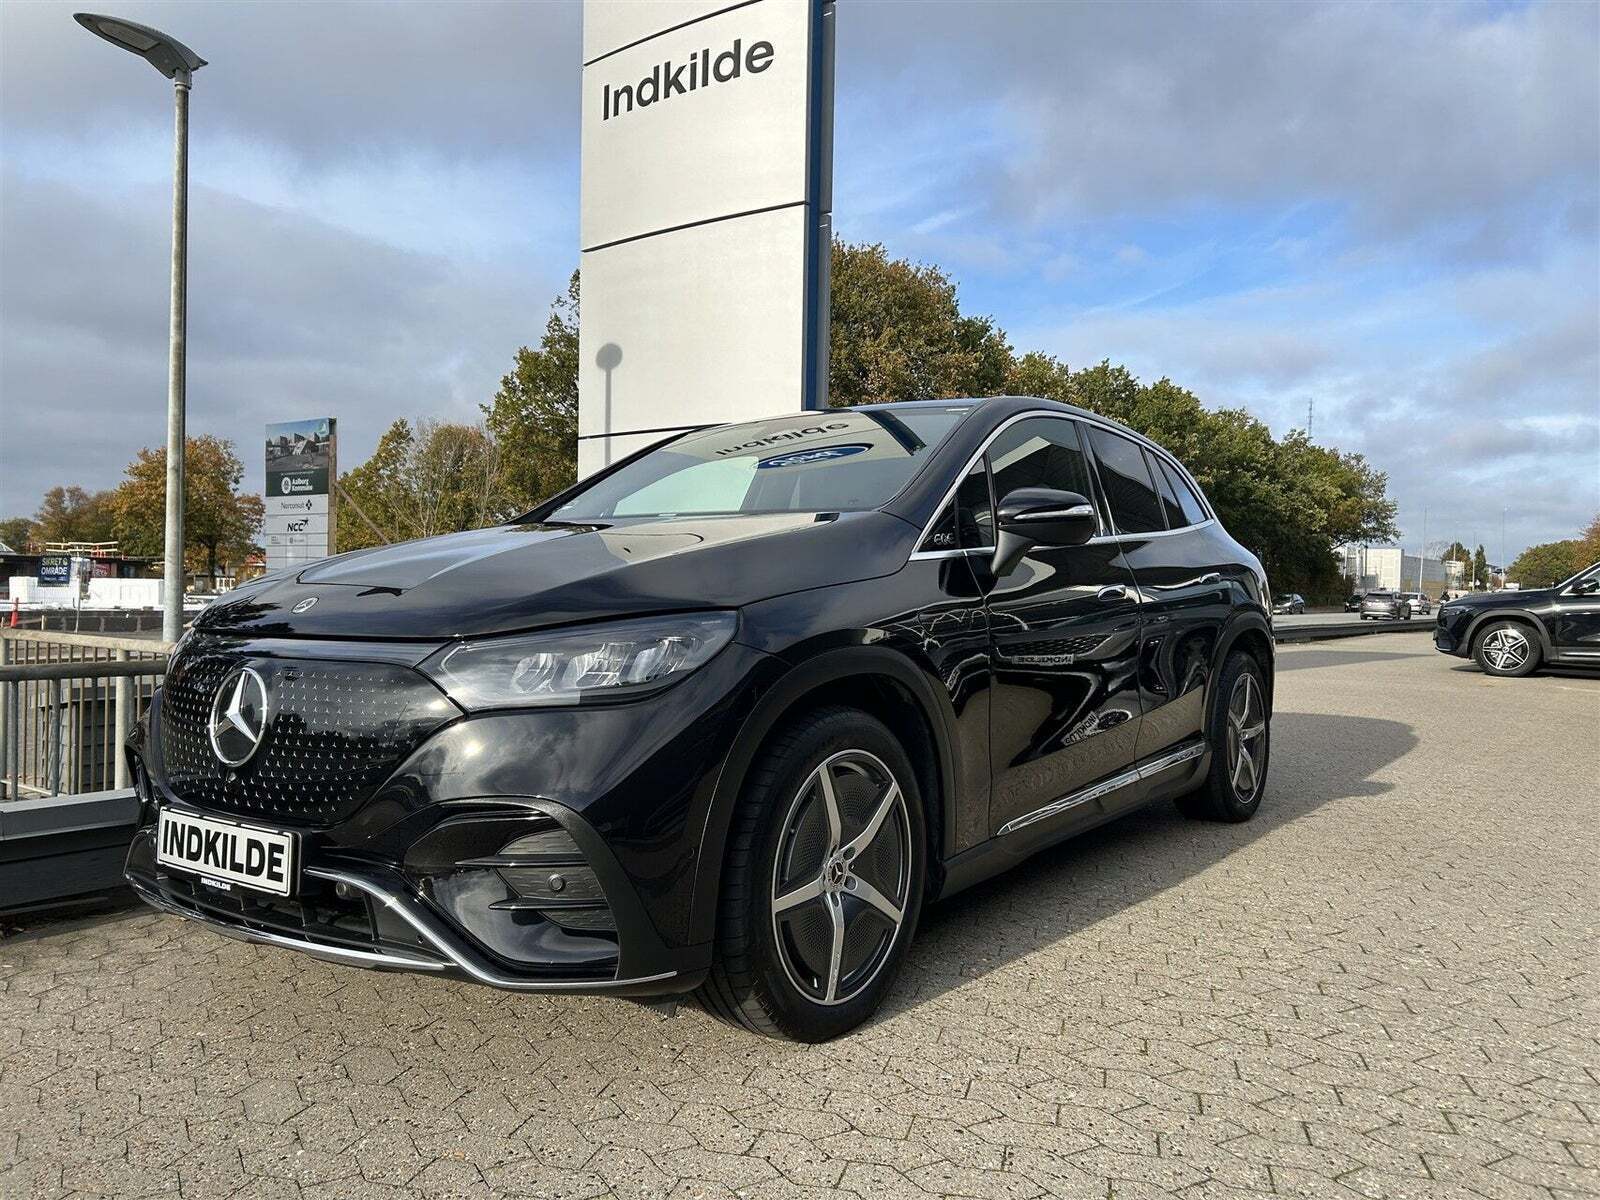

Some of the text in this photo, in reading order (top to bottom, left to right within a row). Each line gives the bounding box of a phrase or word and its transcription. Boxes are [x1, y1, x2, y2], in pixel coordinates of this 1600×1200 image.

[602, 38, 775, 121] Indkilde
[292, 477, 309, 486] Aalborg
[281, 502, 305, 510] Norconsult
[287, 523, 303, 532] NCC
[162, 819, 286, 883] INDKILDE
[201, 877, 231, 891] INDKILDE
